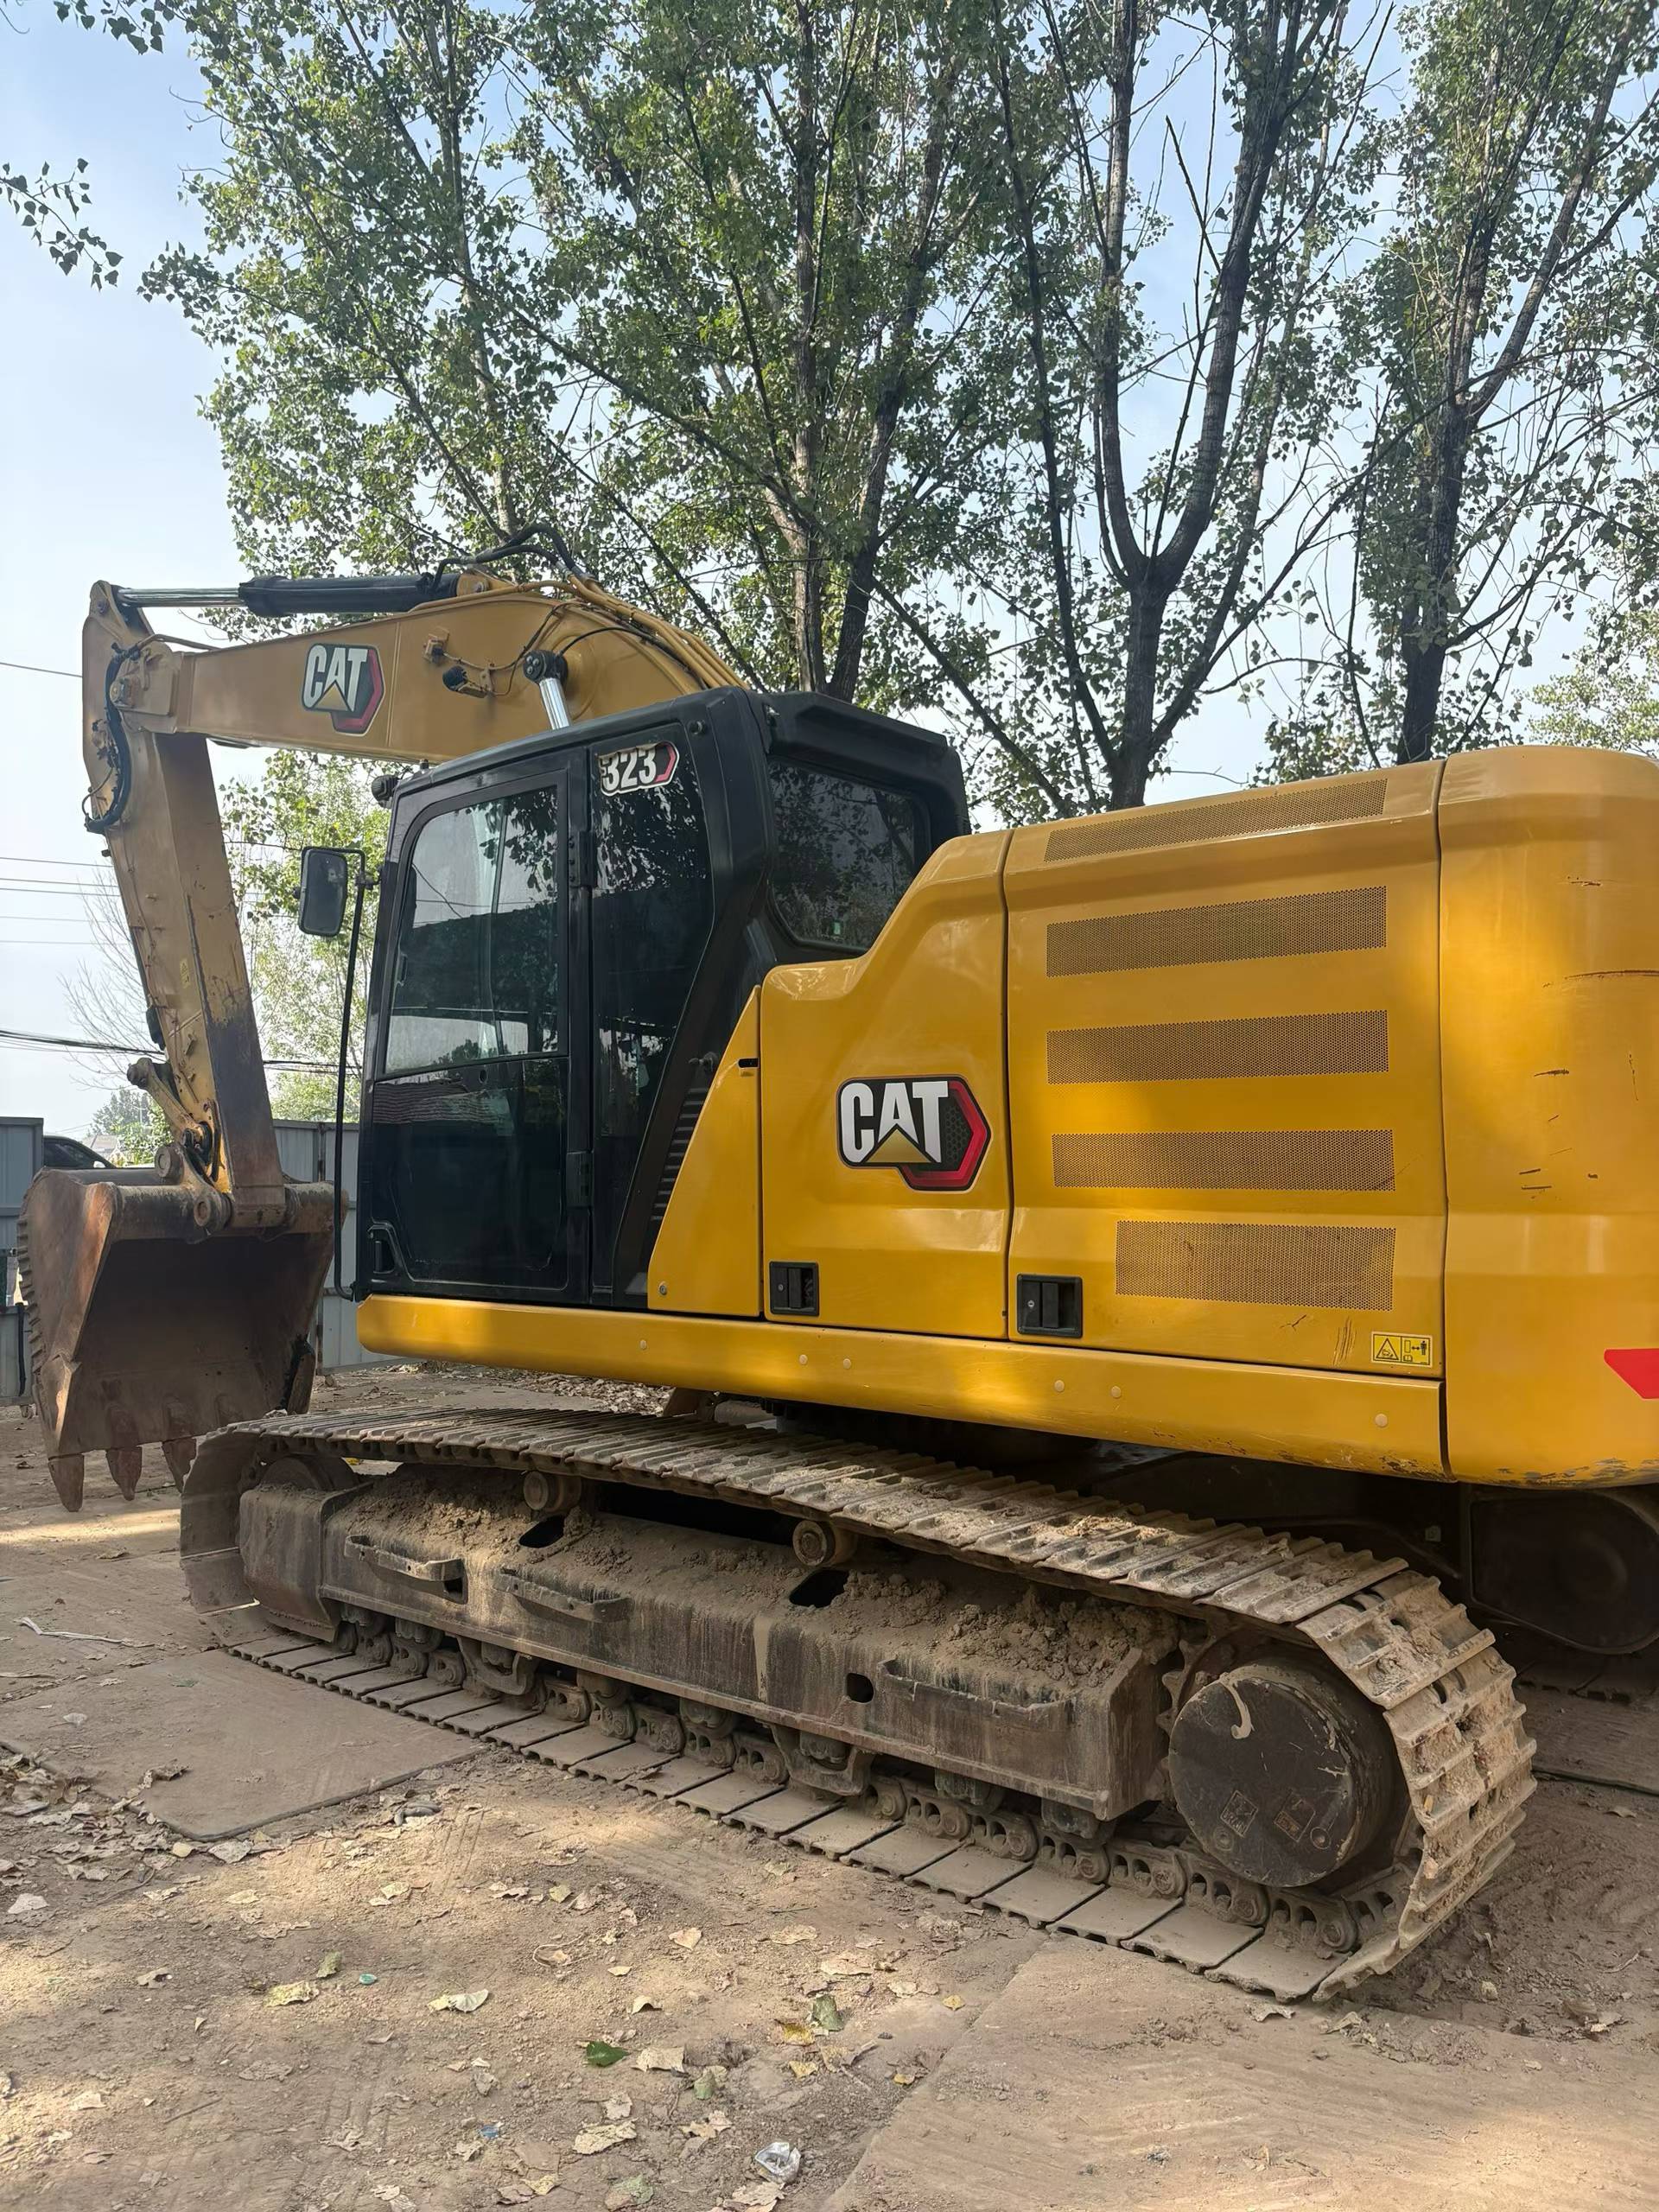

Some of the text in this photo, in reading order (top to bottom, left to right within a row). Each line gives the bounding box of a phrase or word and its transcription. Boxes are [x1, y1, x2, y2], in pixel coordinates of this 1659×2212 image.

[303, 645, 368, 712] CAT
[601, 747, 657, 791] 323
[840, 1080, 949, 1163] CAT
